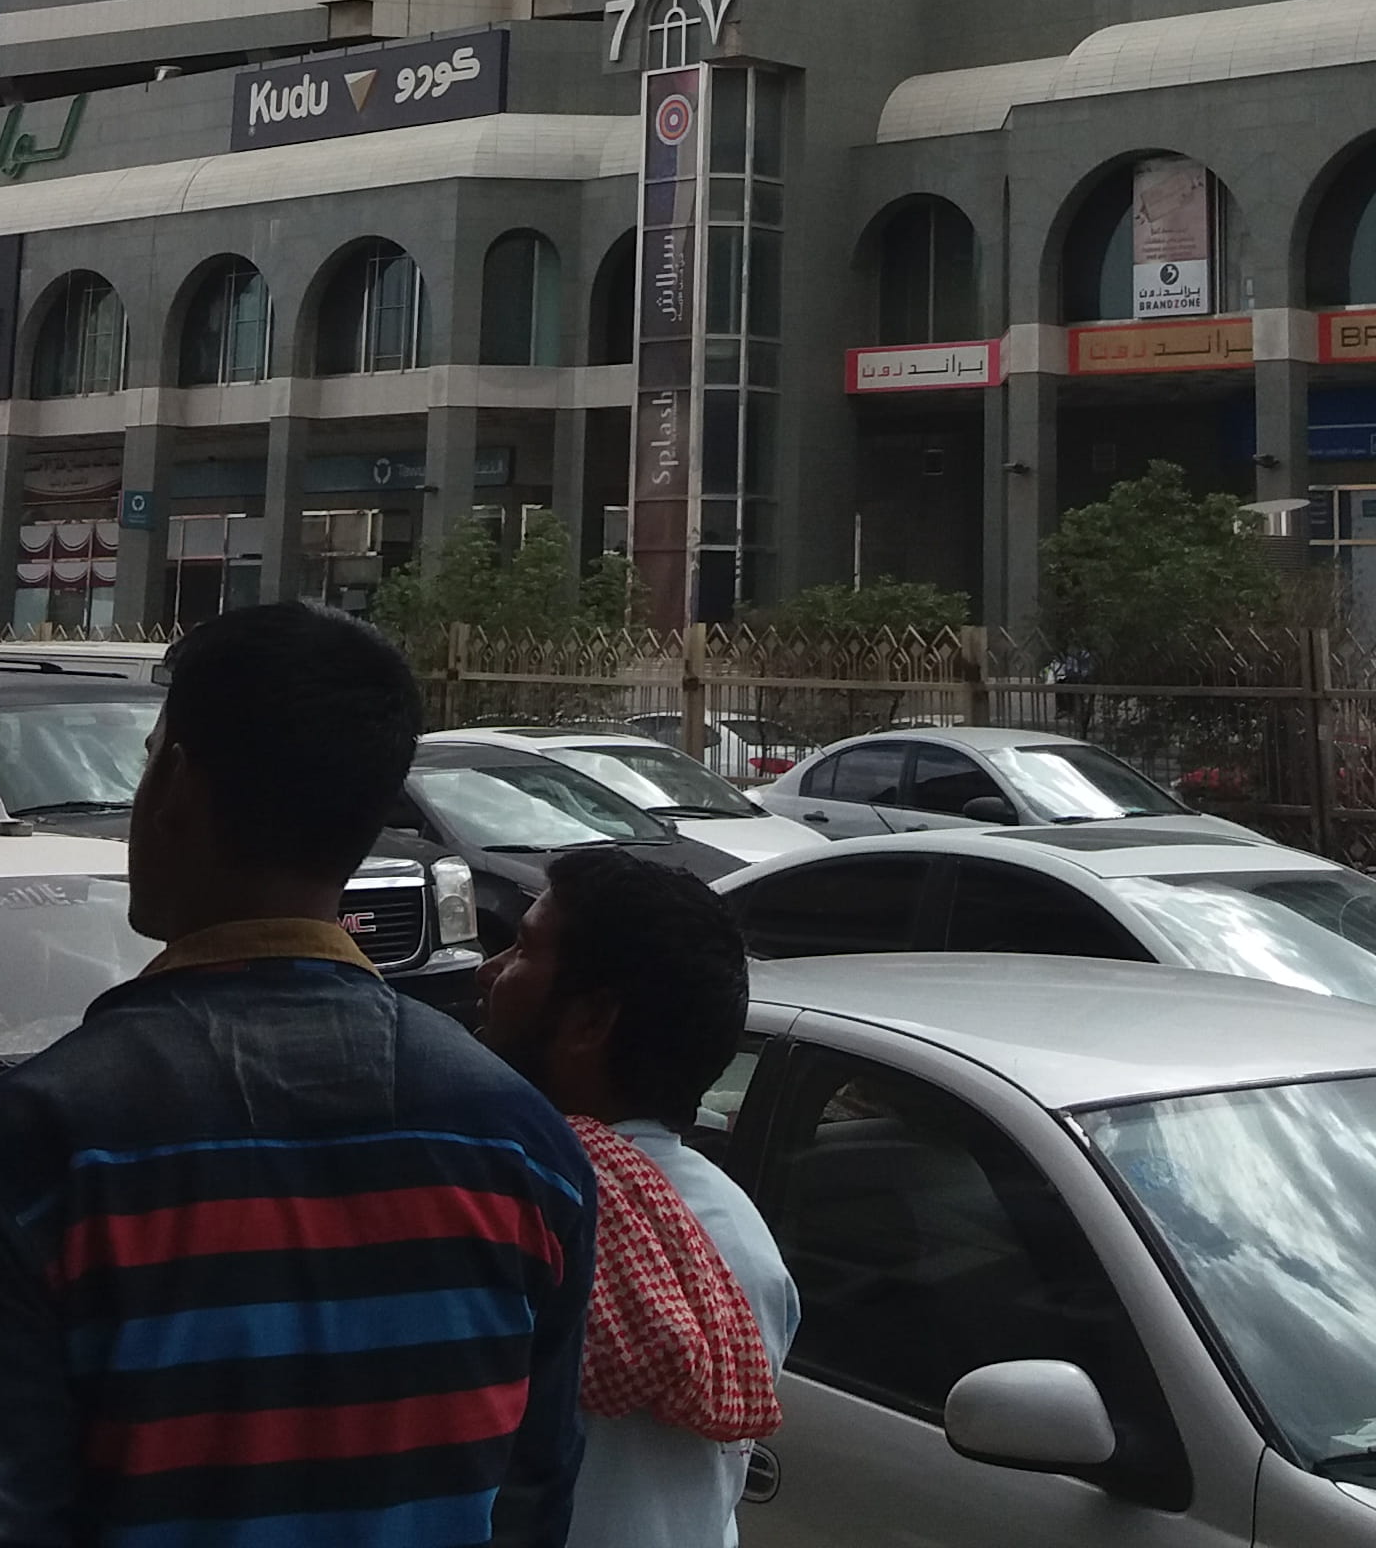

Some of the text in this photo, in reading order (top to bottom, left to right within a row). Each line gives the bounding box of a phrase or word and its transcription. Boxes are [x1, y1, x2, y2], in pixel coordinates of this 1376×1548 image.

[248, 73, 329, 126] Kudu
[394, 47, 481, 103] كودو
[655, 235, 678, 322] سبلاش
[1139, 298, 1201, 311] BRANDZONE
[650, 391, 680, 485] Splash
[336, 912, 376, 933] MC
